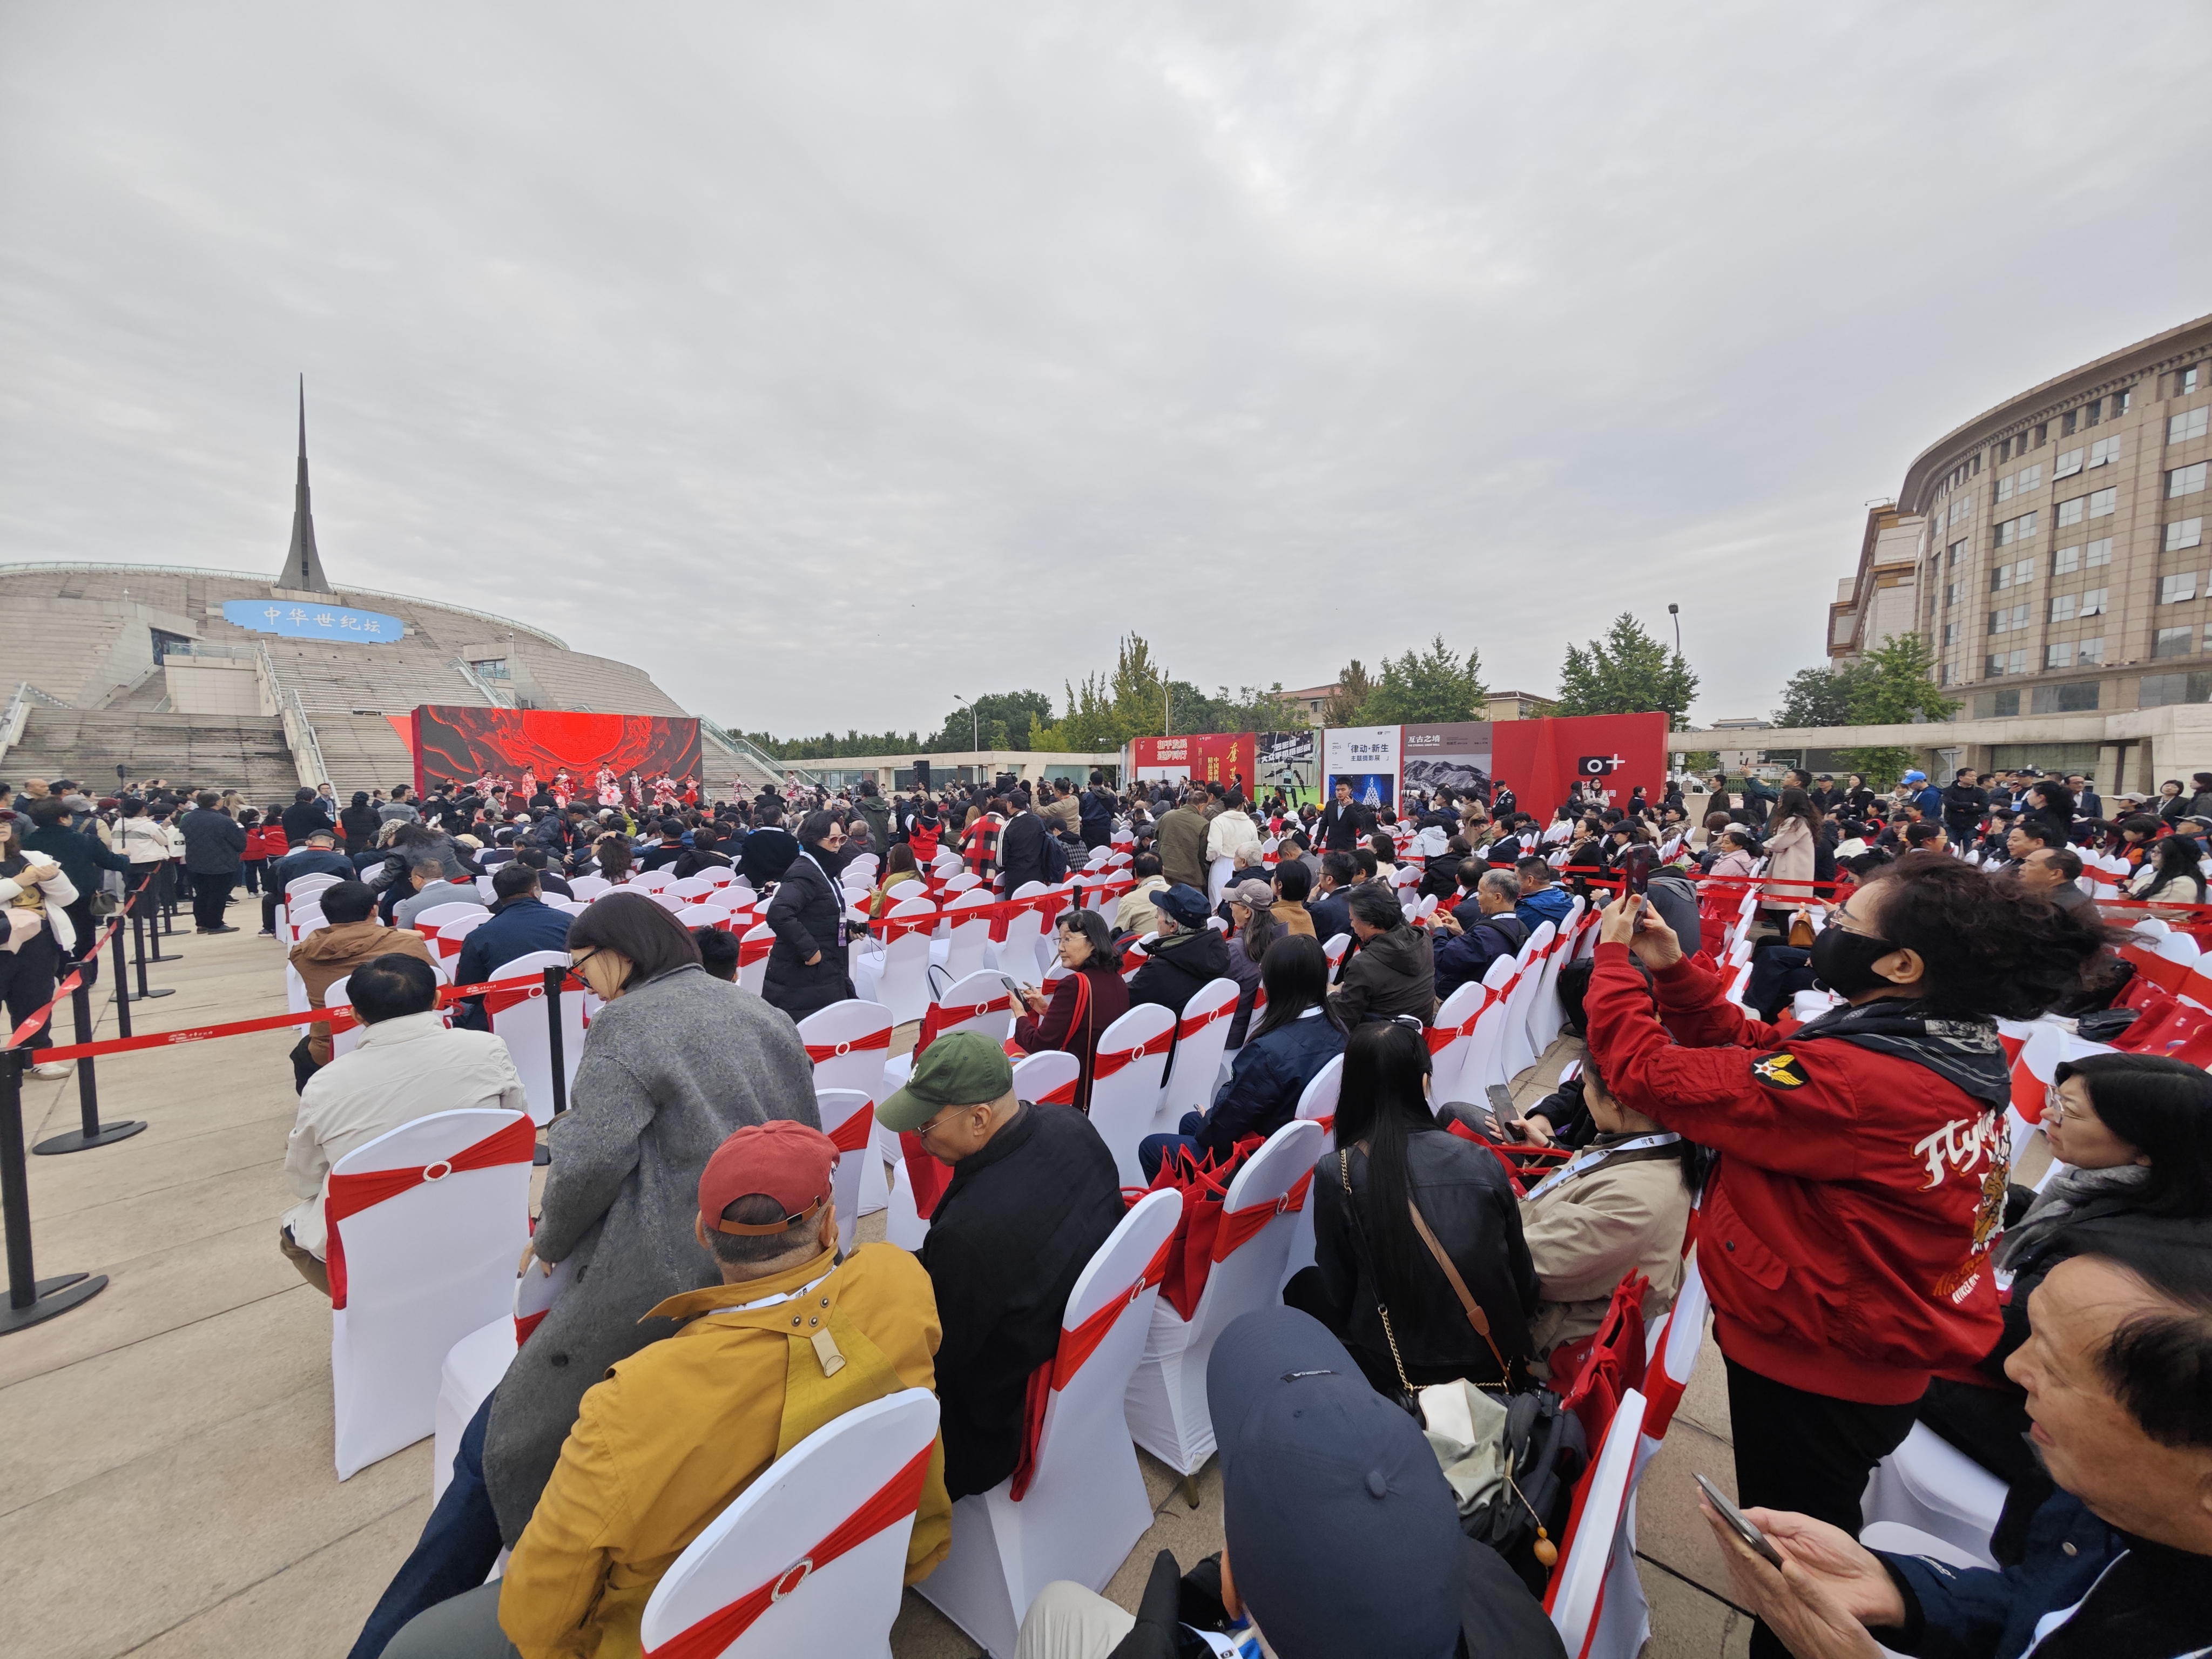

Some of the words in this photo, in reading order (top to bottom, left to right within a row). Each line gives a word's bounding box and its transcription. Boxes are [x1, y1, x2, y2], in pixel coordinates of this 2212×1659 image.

[264, 606, 381, 634] 中华世纪坛
[1157, 738, 1188, 750] 和平发展
[1408, 735, 1440, 743] 亘古之墙
